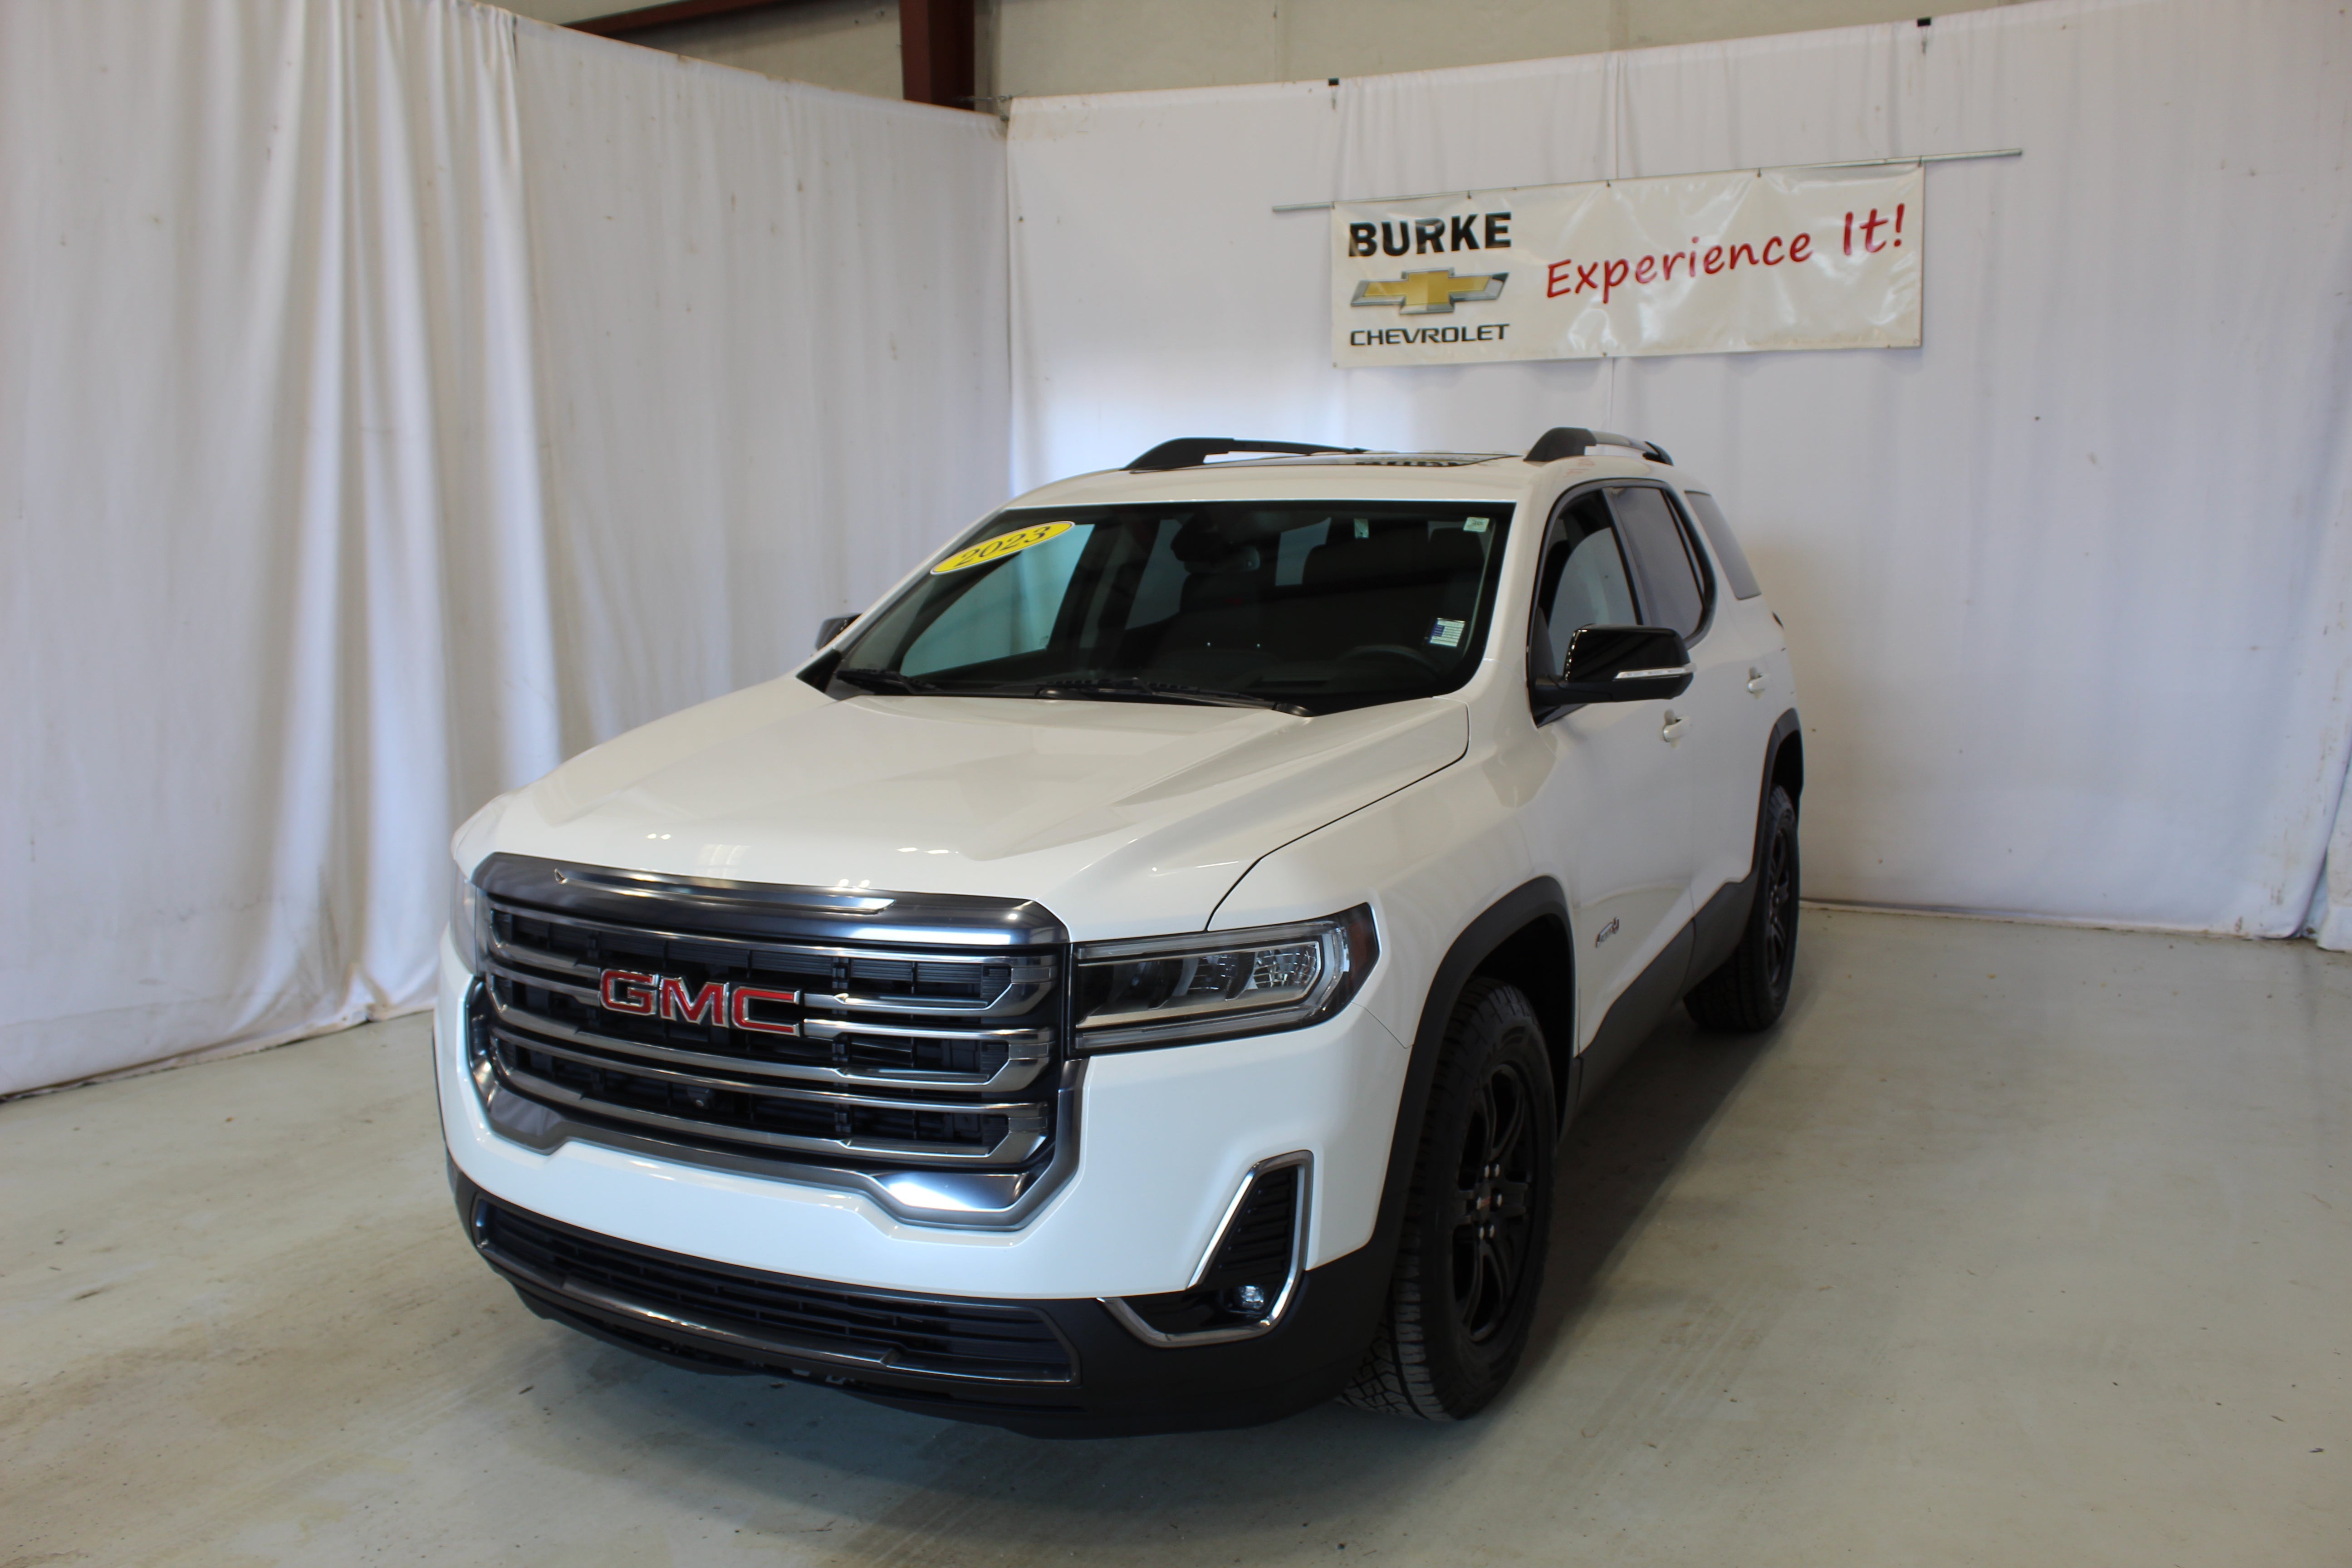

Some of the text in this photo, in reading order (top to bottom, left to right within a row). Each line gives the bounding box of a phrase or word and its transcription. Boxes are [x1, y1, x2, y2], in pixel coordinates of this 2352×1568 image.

[1349, 211, 1512, 257] BURKE
[1546, 203, 1905, 304] Experience It!
[1350, 323, 1510, 346] CHEVROLET
[954, 525, 1051, 567] 2023
[600, 968, 801, 1037] GMC
